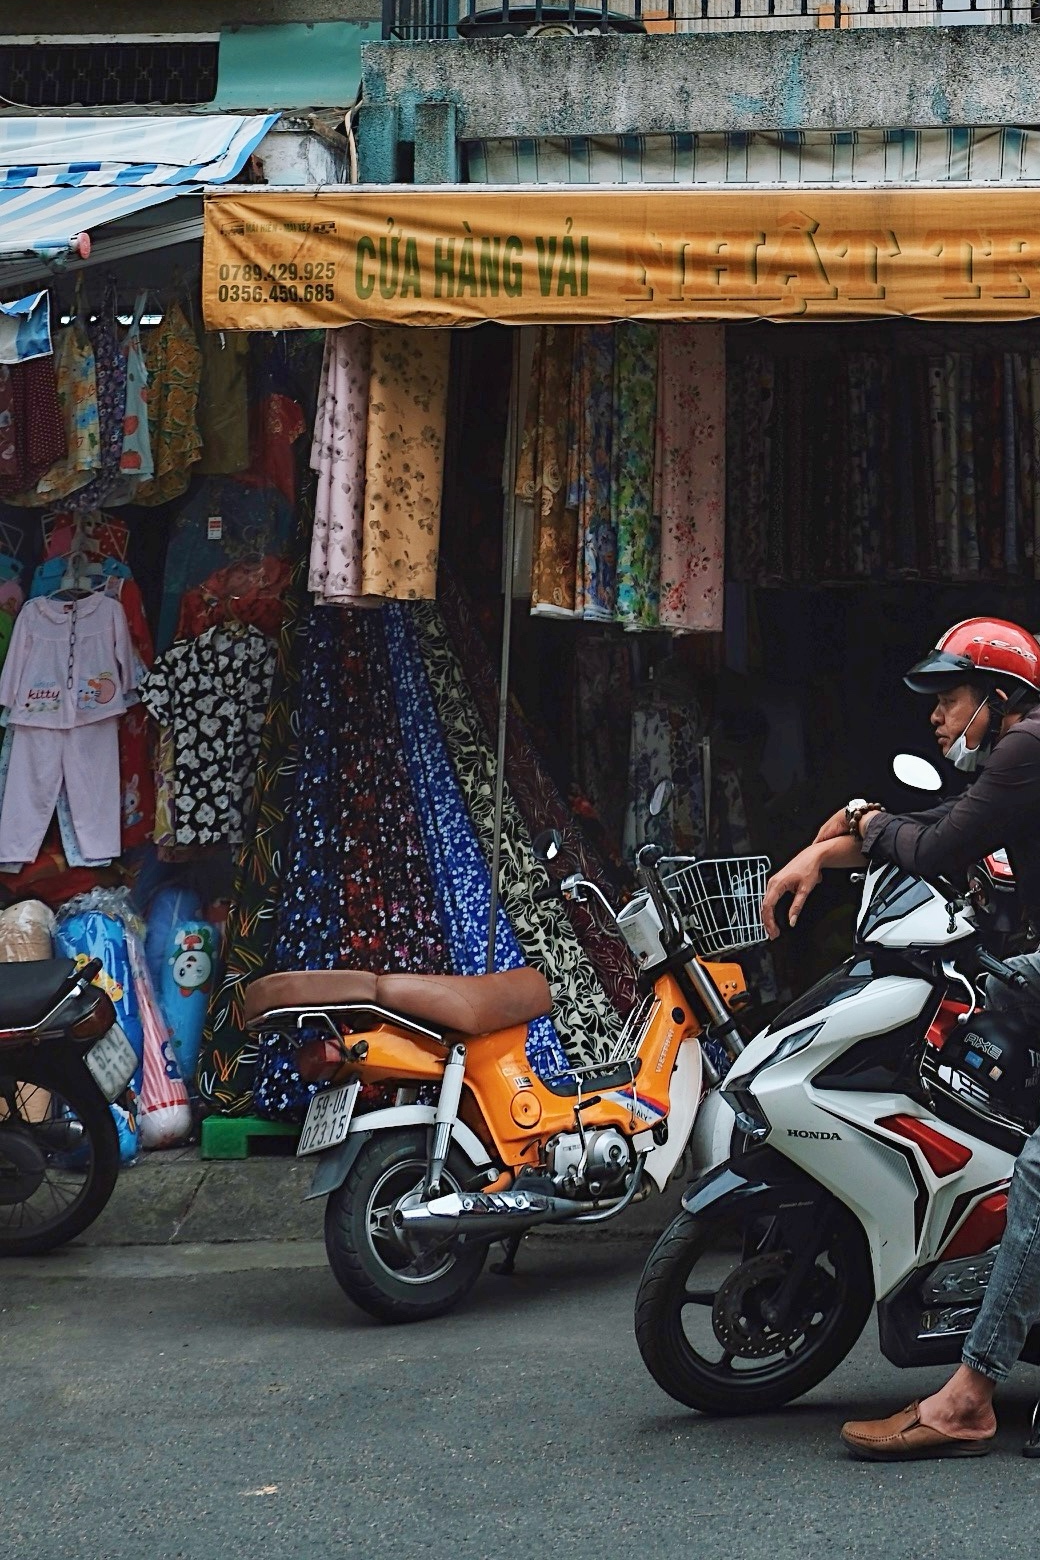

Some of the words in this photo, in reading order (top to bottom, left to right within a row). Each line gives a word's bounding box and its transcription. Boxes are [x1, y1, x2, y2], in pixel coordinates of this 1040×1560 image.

[219, 262, 335, 282] 0789.429.925
[355, 217, 422, 300] CỬA
[434, 221, 524, 298] HÀNG
[535, 217, 589, 297] VẢI
[618, 210, 900, 315] NHẬT
[218, 284, 335, 303] 0356.450.685
[28, 689, 60, 702] kitty
[963, 1032, 1003, 1061] AXE
[301, 1114, 347, 1151] 023.15
[787, 1128, 843, 1141] HONDA
